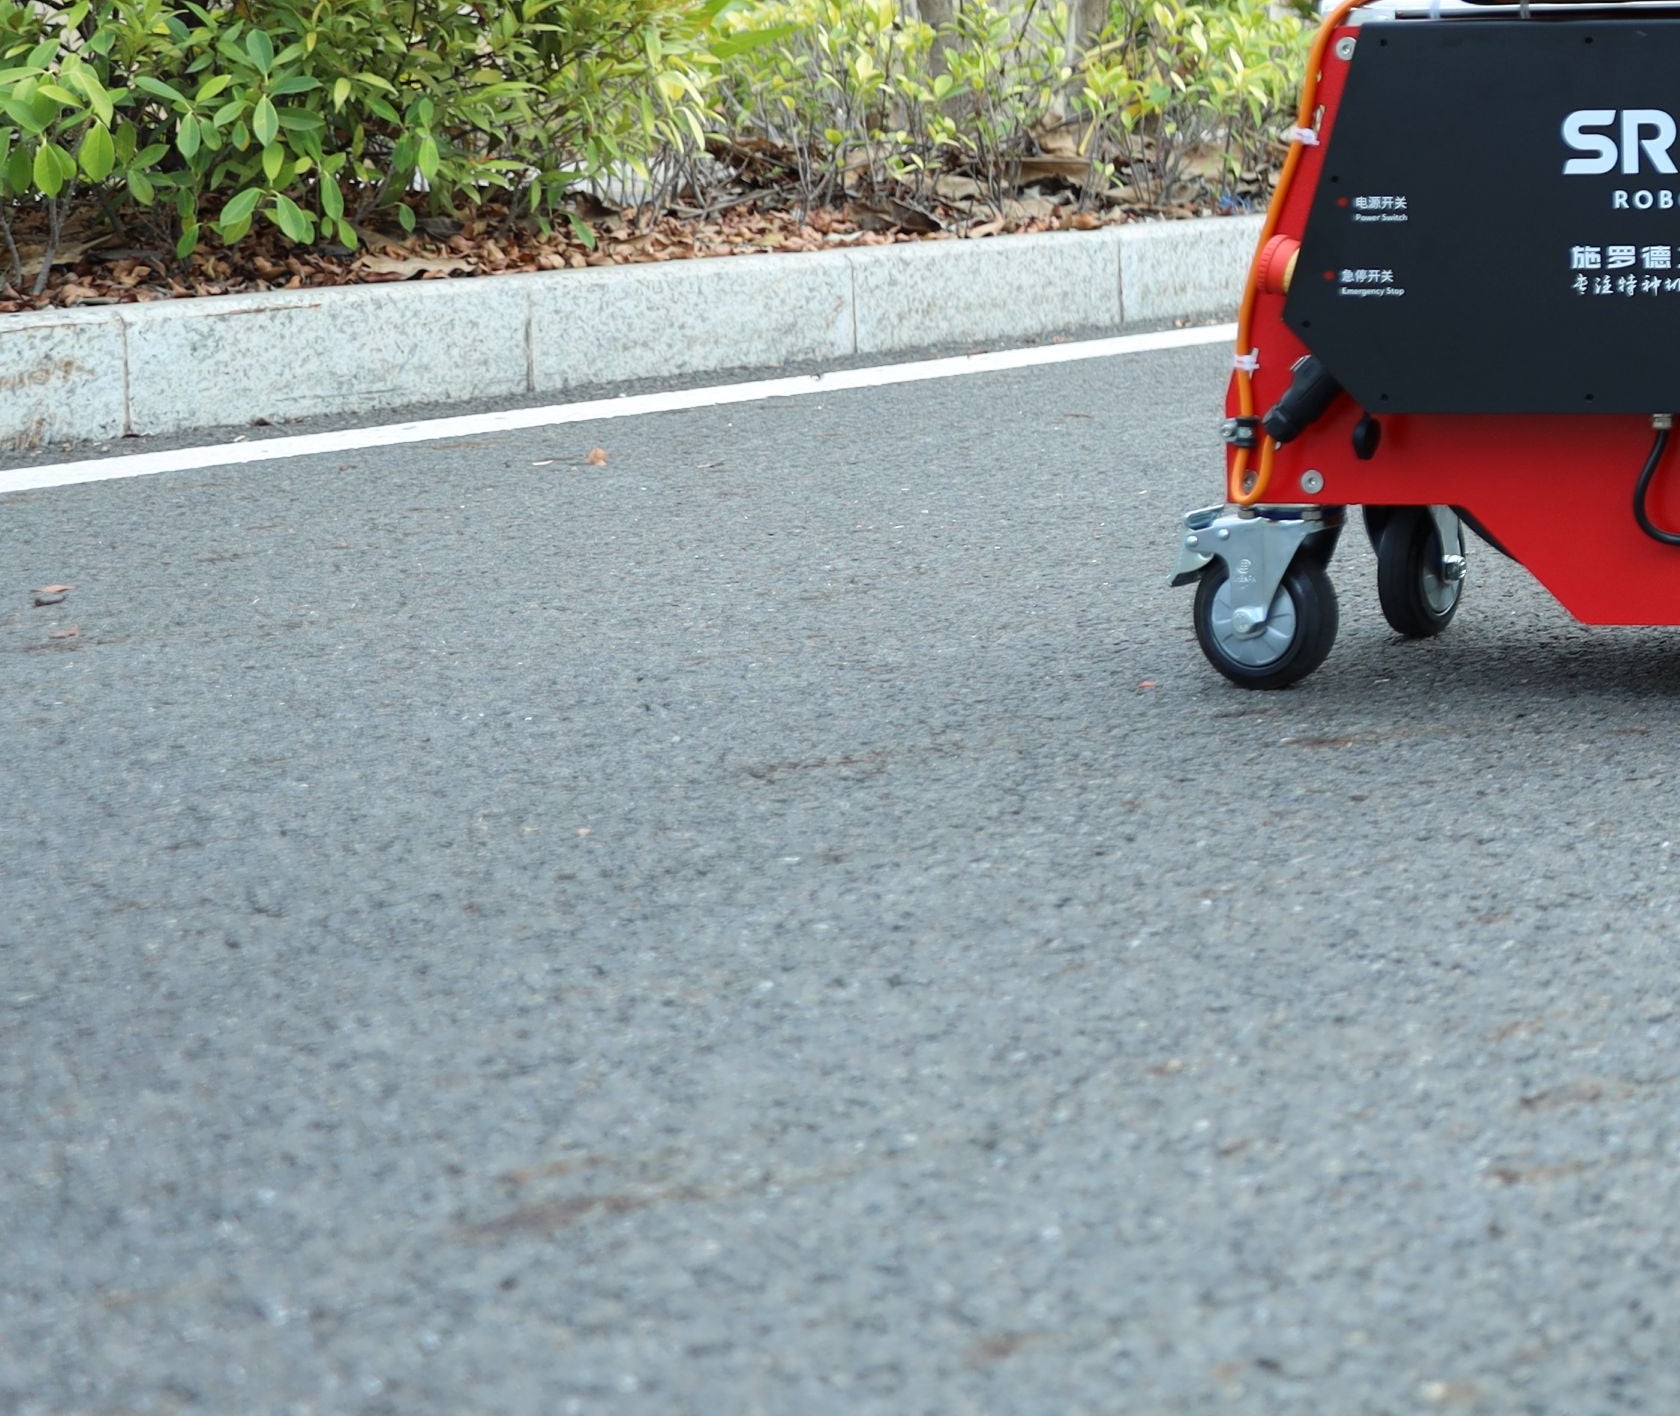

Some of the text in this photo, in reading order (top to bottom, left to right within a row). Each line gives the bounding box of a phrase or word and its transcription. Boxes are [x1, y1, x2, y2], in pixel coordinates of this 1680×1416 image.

[1354, 196, 1408, 210] 电源开关
[1354, 213, 1408, 222] Power Switch
[1341, 269, 1394, 283] 急停开关
[1341, 286, 1405, 297] Emergency Stop
